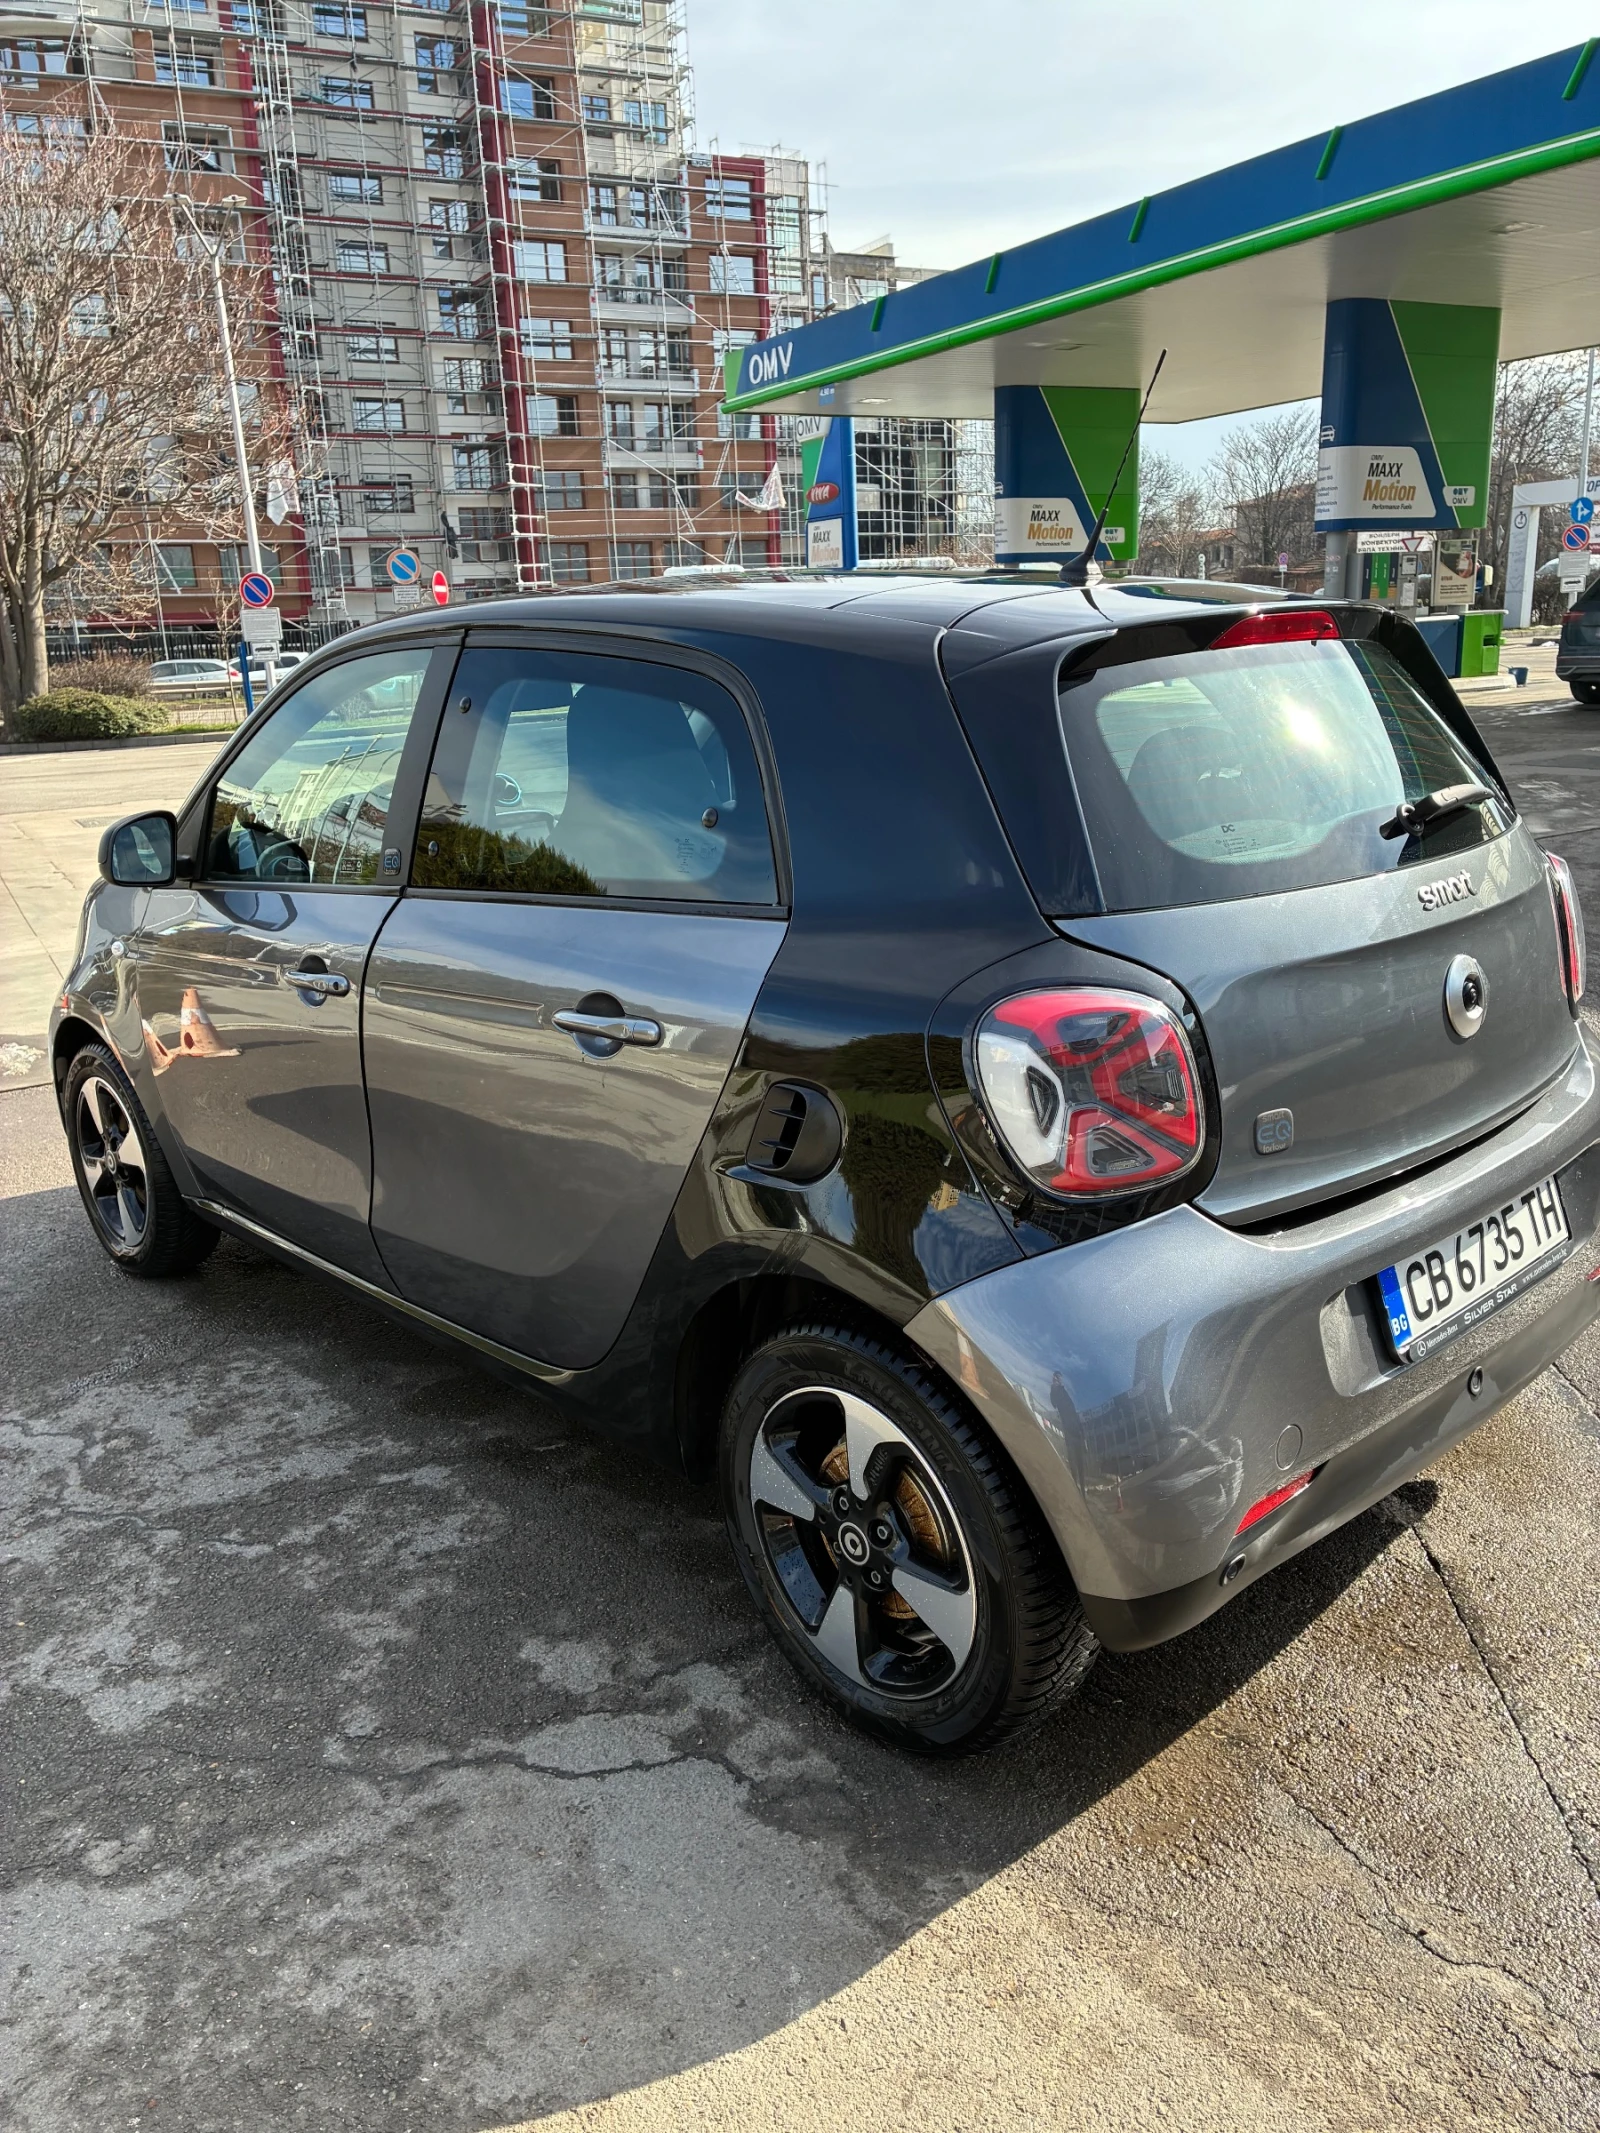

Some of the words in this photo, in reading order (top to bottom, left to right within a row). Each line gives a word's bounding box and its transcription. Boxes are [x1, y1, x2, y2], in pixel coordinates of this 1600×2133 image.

[749, 341, 793, 384] OMV
[797, 416, 821, 436] OMV
[1367, 462, 1404, 478] MAXX
[810, 484, 830, 502] VIVA
[1362, 479, 1417, 501] Motion
[1452, 497, 1468, 505] OMV
[1030, 510, 1061, 522] MAXX
[812, 530, 832, 544] MAXX
[1027, 523, 1074, 541] Motion
[811, 544, 840, 563] Motion
[384, 855, 399, 869] EQ
[1417, 868, 1478, 912] smart
[1261, 1111, 1285, 1123] smart
[1257, 1119, 1292, 1145] EQ
[1262, 1142, 1287, 1154] forfour
[1405, 1250, 1453, 1322] CB
[1454, 1203, 1524, 1293] 6735
[1520, 1180, 1562, 1247] TH
[1426, 1323, 1459, 1348] Mercedes-Benz
[1463, 1298, 1495, 1325] SILVER
[1496, 1282, 1518, 1303] STAR
[1391, 1314, 1408, 1336] BG
